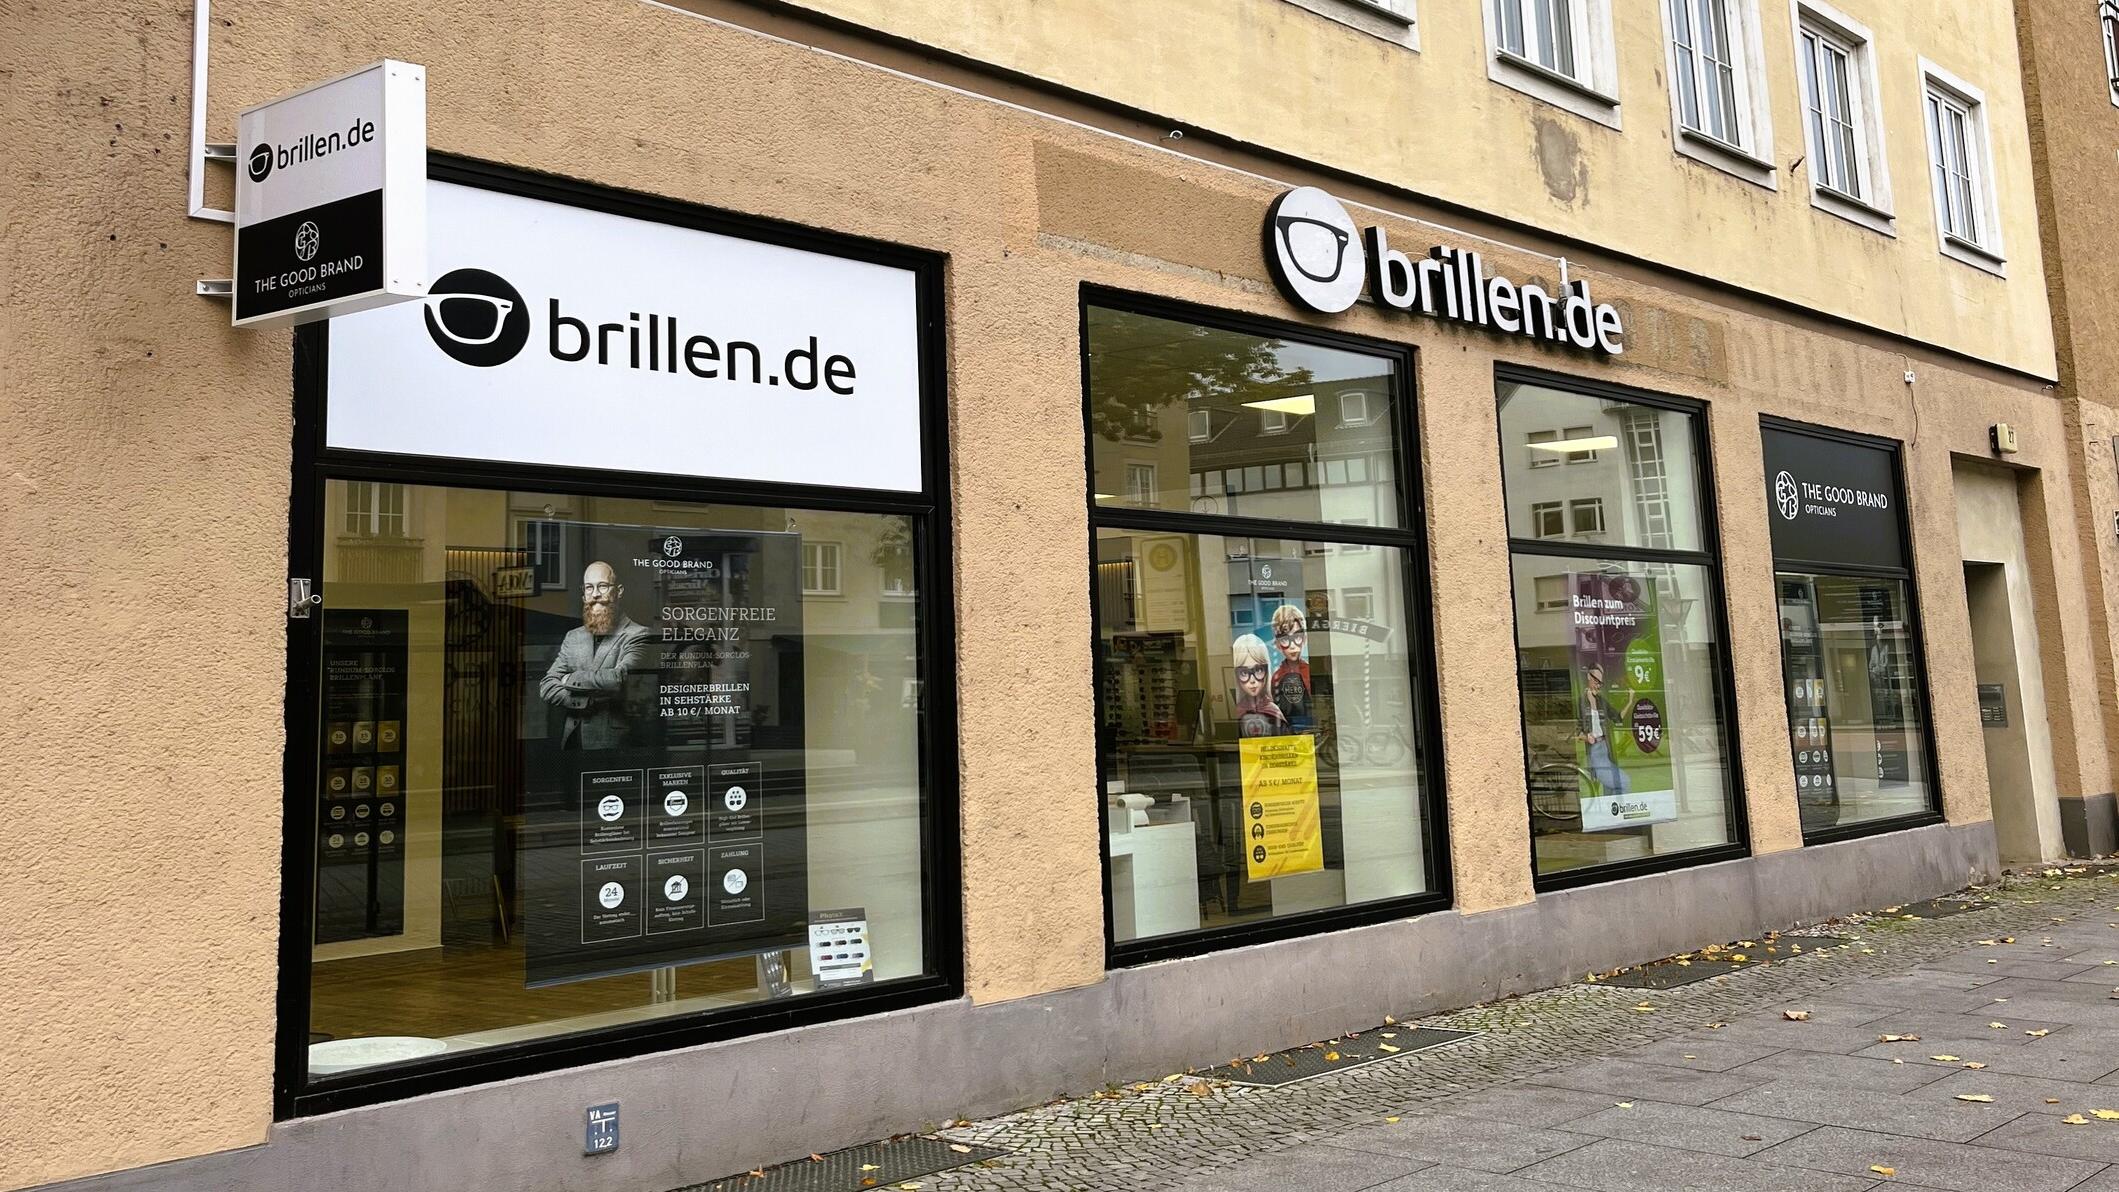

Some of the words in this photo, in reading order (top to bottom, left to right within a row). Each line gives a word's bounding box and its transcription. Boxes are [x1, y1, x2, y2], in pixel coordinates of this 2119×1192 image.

[278, 118, 374, 169] brillen.de
[255, 276, 277, 293] THE
[280, 267, 316, 286] GOOD
[320, 255, 363, 278] BRAND
[288, 282, 326, 298] OPTICIANS
[1367, 226, 1623, 354] brillen.de
[548, 298, 857, 394] brillen.de
[1802, 482, 1823, 501] THE
[1824, 486, 1855, 505] GOOD
[1857, 490, 1888, 509] BRAND
[1805, 504, 1837, 517] OPTICIANS
[633, 558, 650, 567] THE
[652, 559, 681, 568] GOOD
[682, 560, 713, 569] BRAND
[1573, 594, 1604, 609] Brillen
[1604, 599, 1624, 610] zum
[662, 606, 776, 621] SORGENFREIE
[1574, 611, 1636, 630] Discountpreis
[662, 627, 740, 641] ELEGANZ
[660, 652, 677, 660] DER
[660, 683, 750, 694] DESIGNERBRILLEN
[660, 697, 672, 705] IN
[674, 694, 732, 705] SEHSTÄRKE
[660, 708, 674, 717] AB
[677, 707, 688, 716] 10
[704, 705, 741, 715] MONAT
[659, 772, 692, 780] EXKLUSIVE
[720, 768, 750, 776] QUALITÄT
[592, 776, 633, 784] SORGENFREI
[1619, 802, 1648, 814] brillen.de
[720, 850, 750, 858] ZAHLUNG
[596, 862, 628, 871] LAUFZEIT
[658, 856, 694, 865] SICHERHEIT
[605, 887, 618, 898] 24
[590, 1110, 601, 1120] VA
